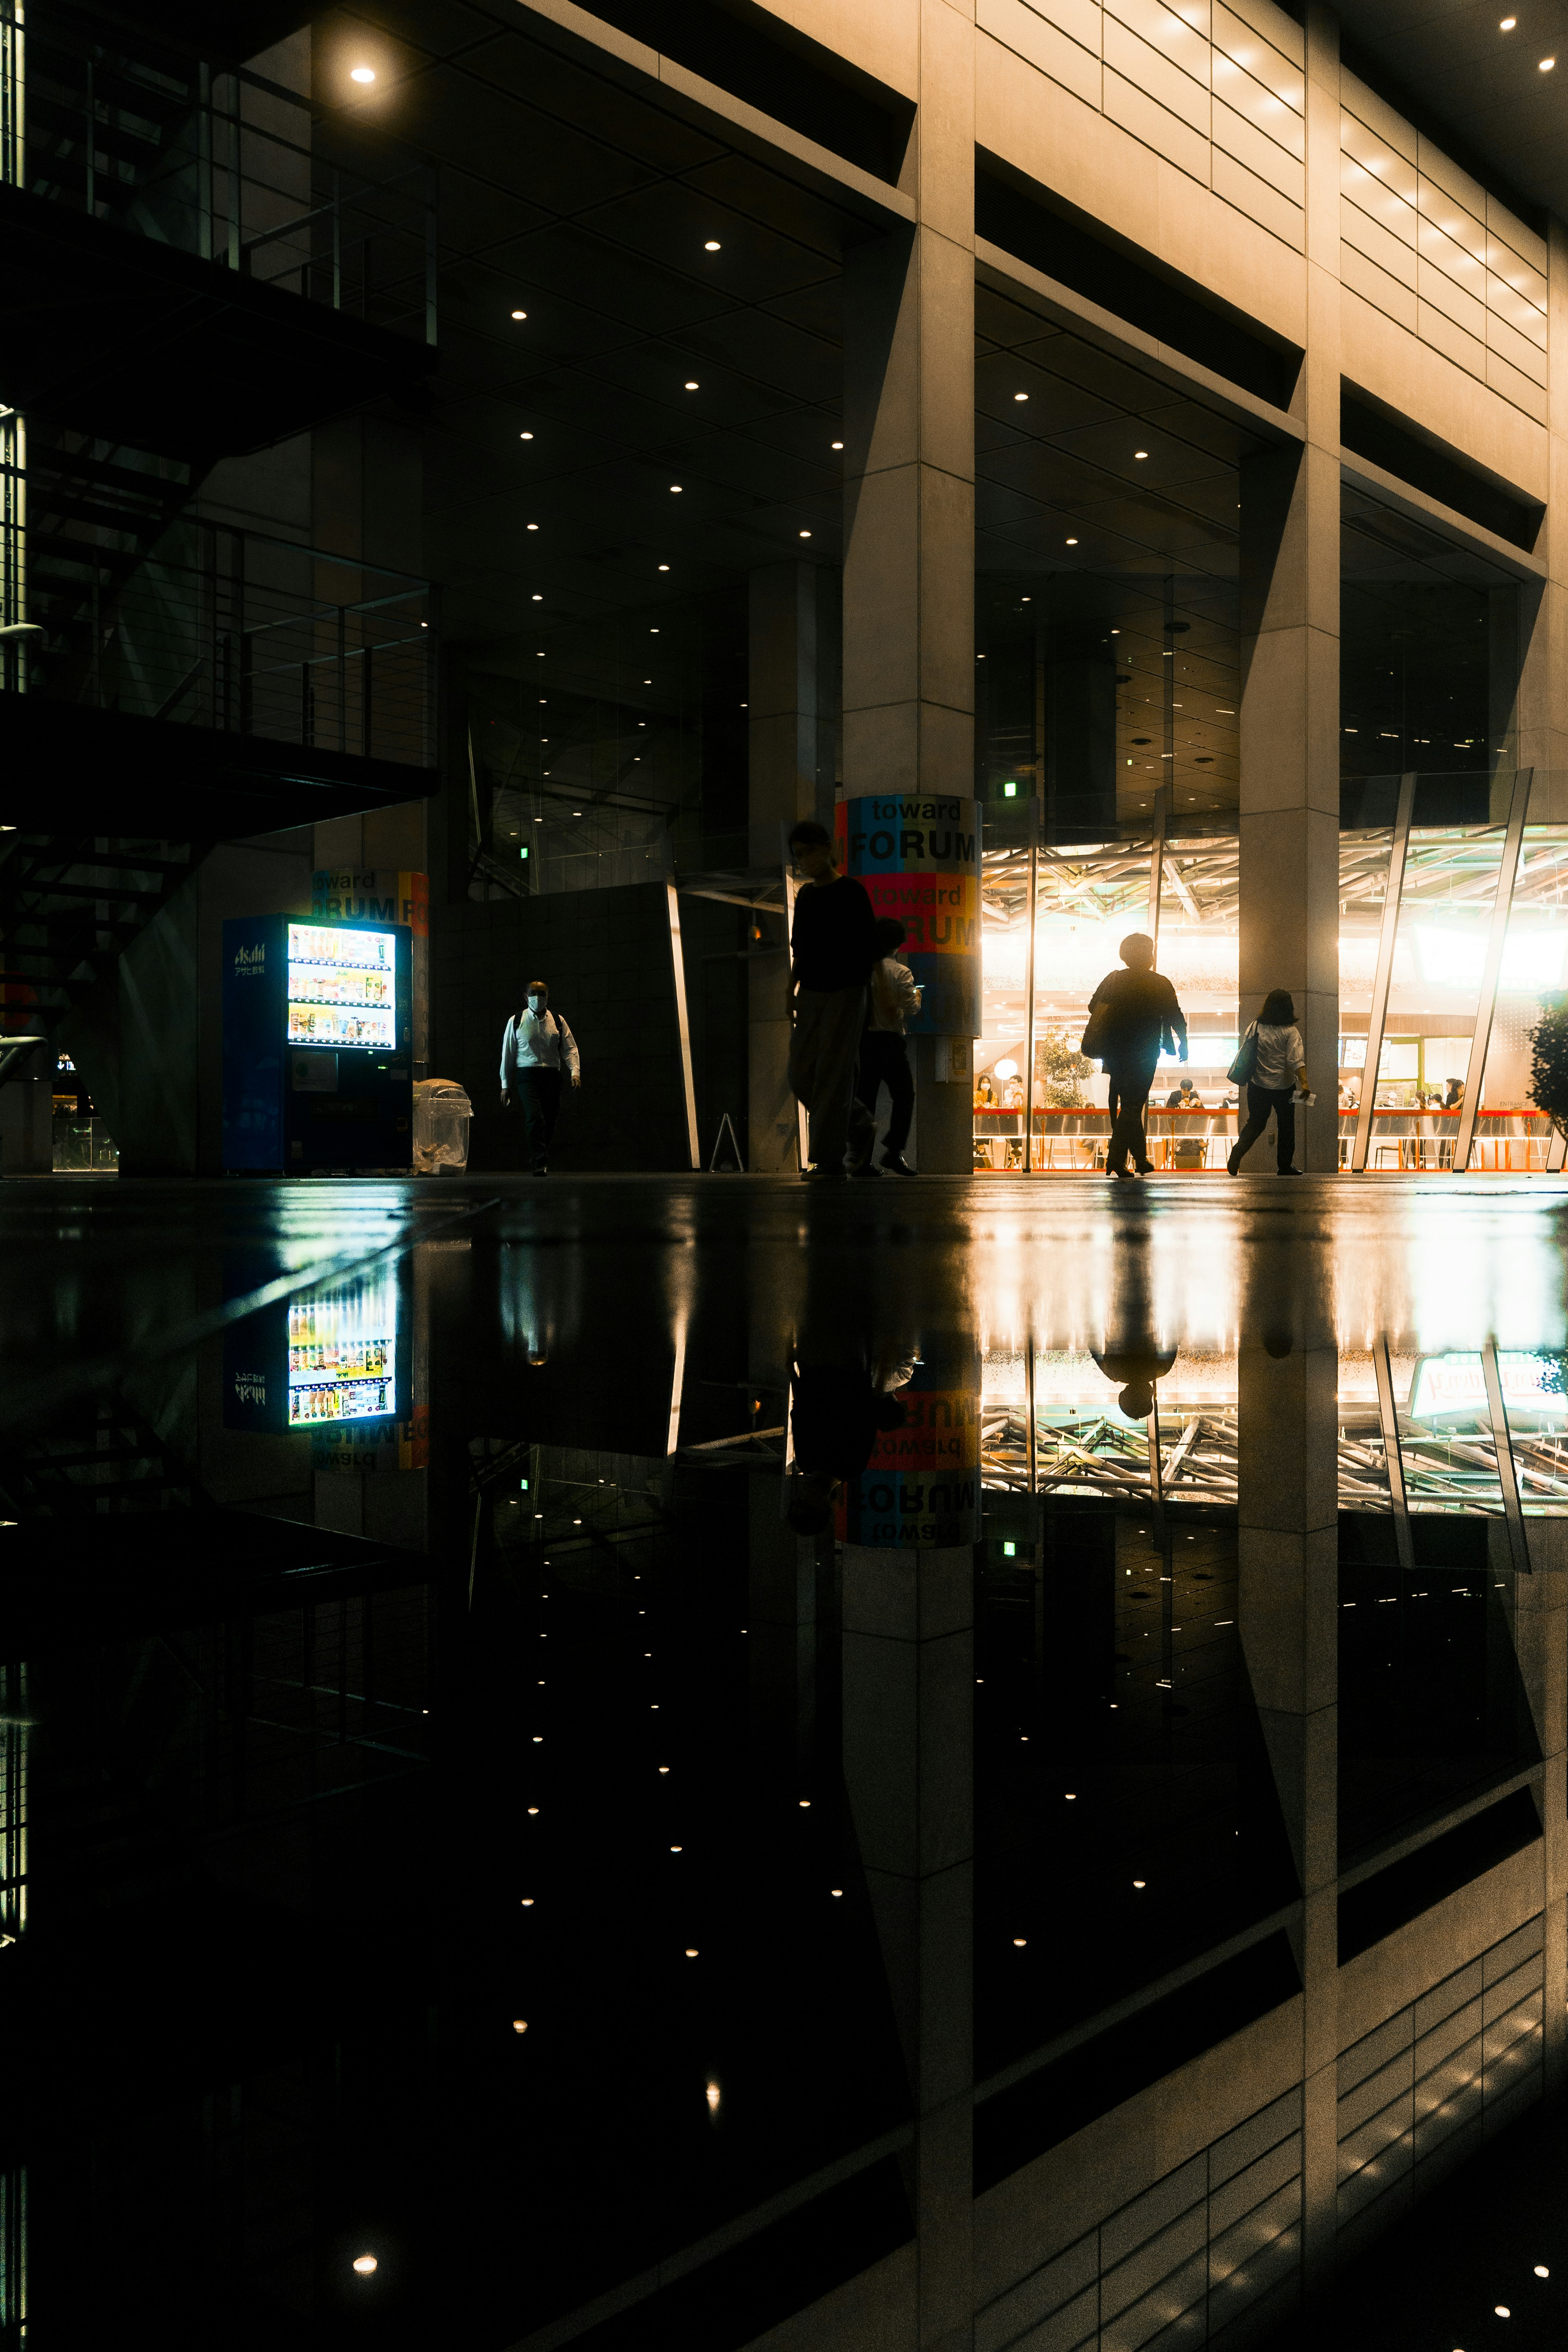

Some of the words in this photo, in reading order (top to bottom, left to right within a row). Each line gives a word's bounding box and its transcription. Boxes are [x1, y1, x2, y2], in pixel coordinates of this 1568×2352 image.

[872, 800, 961, 821] toward
[851, 830, 975, 863] FORUM
[873, 885, 961, 905] toward
[900, 915, 975, 946] RUM
[235, 943, 265, 965] Asahi
[235, 964, 265, 976] アサヒ飲料
[1452, 978, 1534, 988] DOUNUTS
